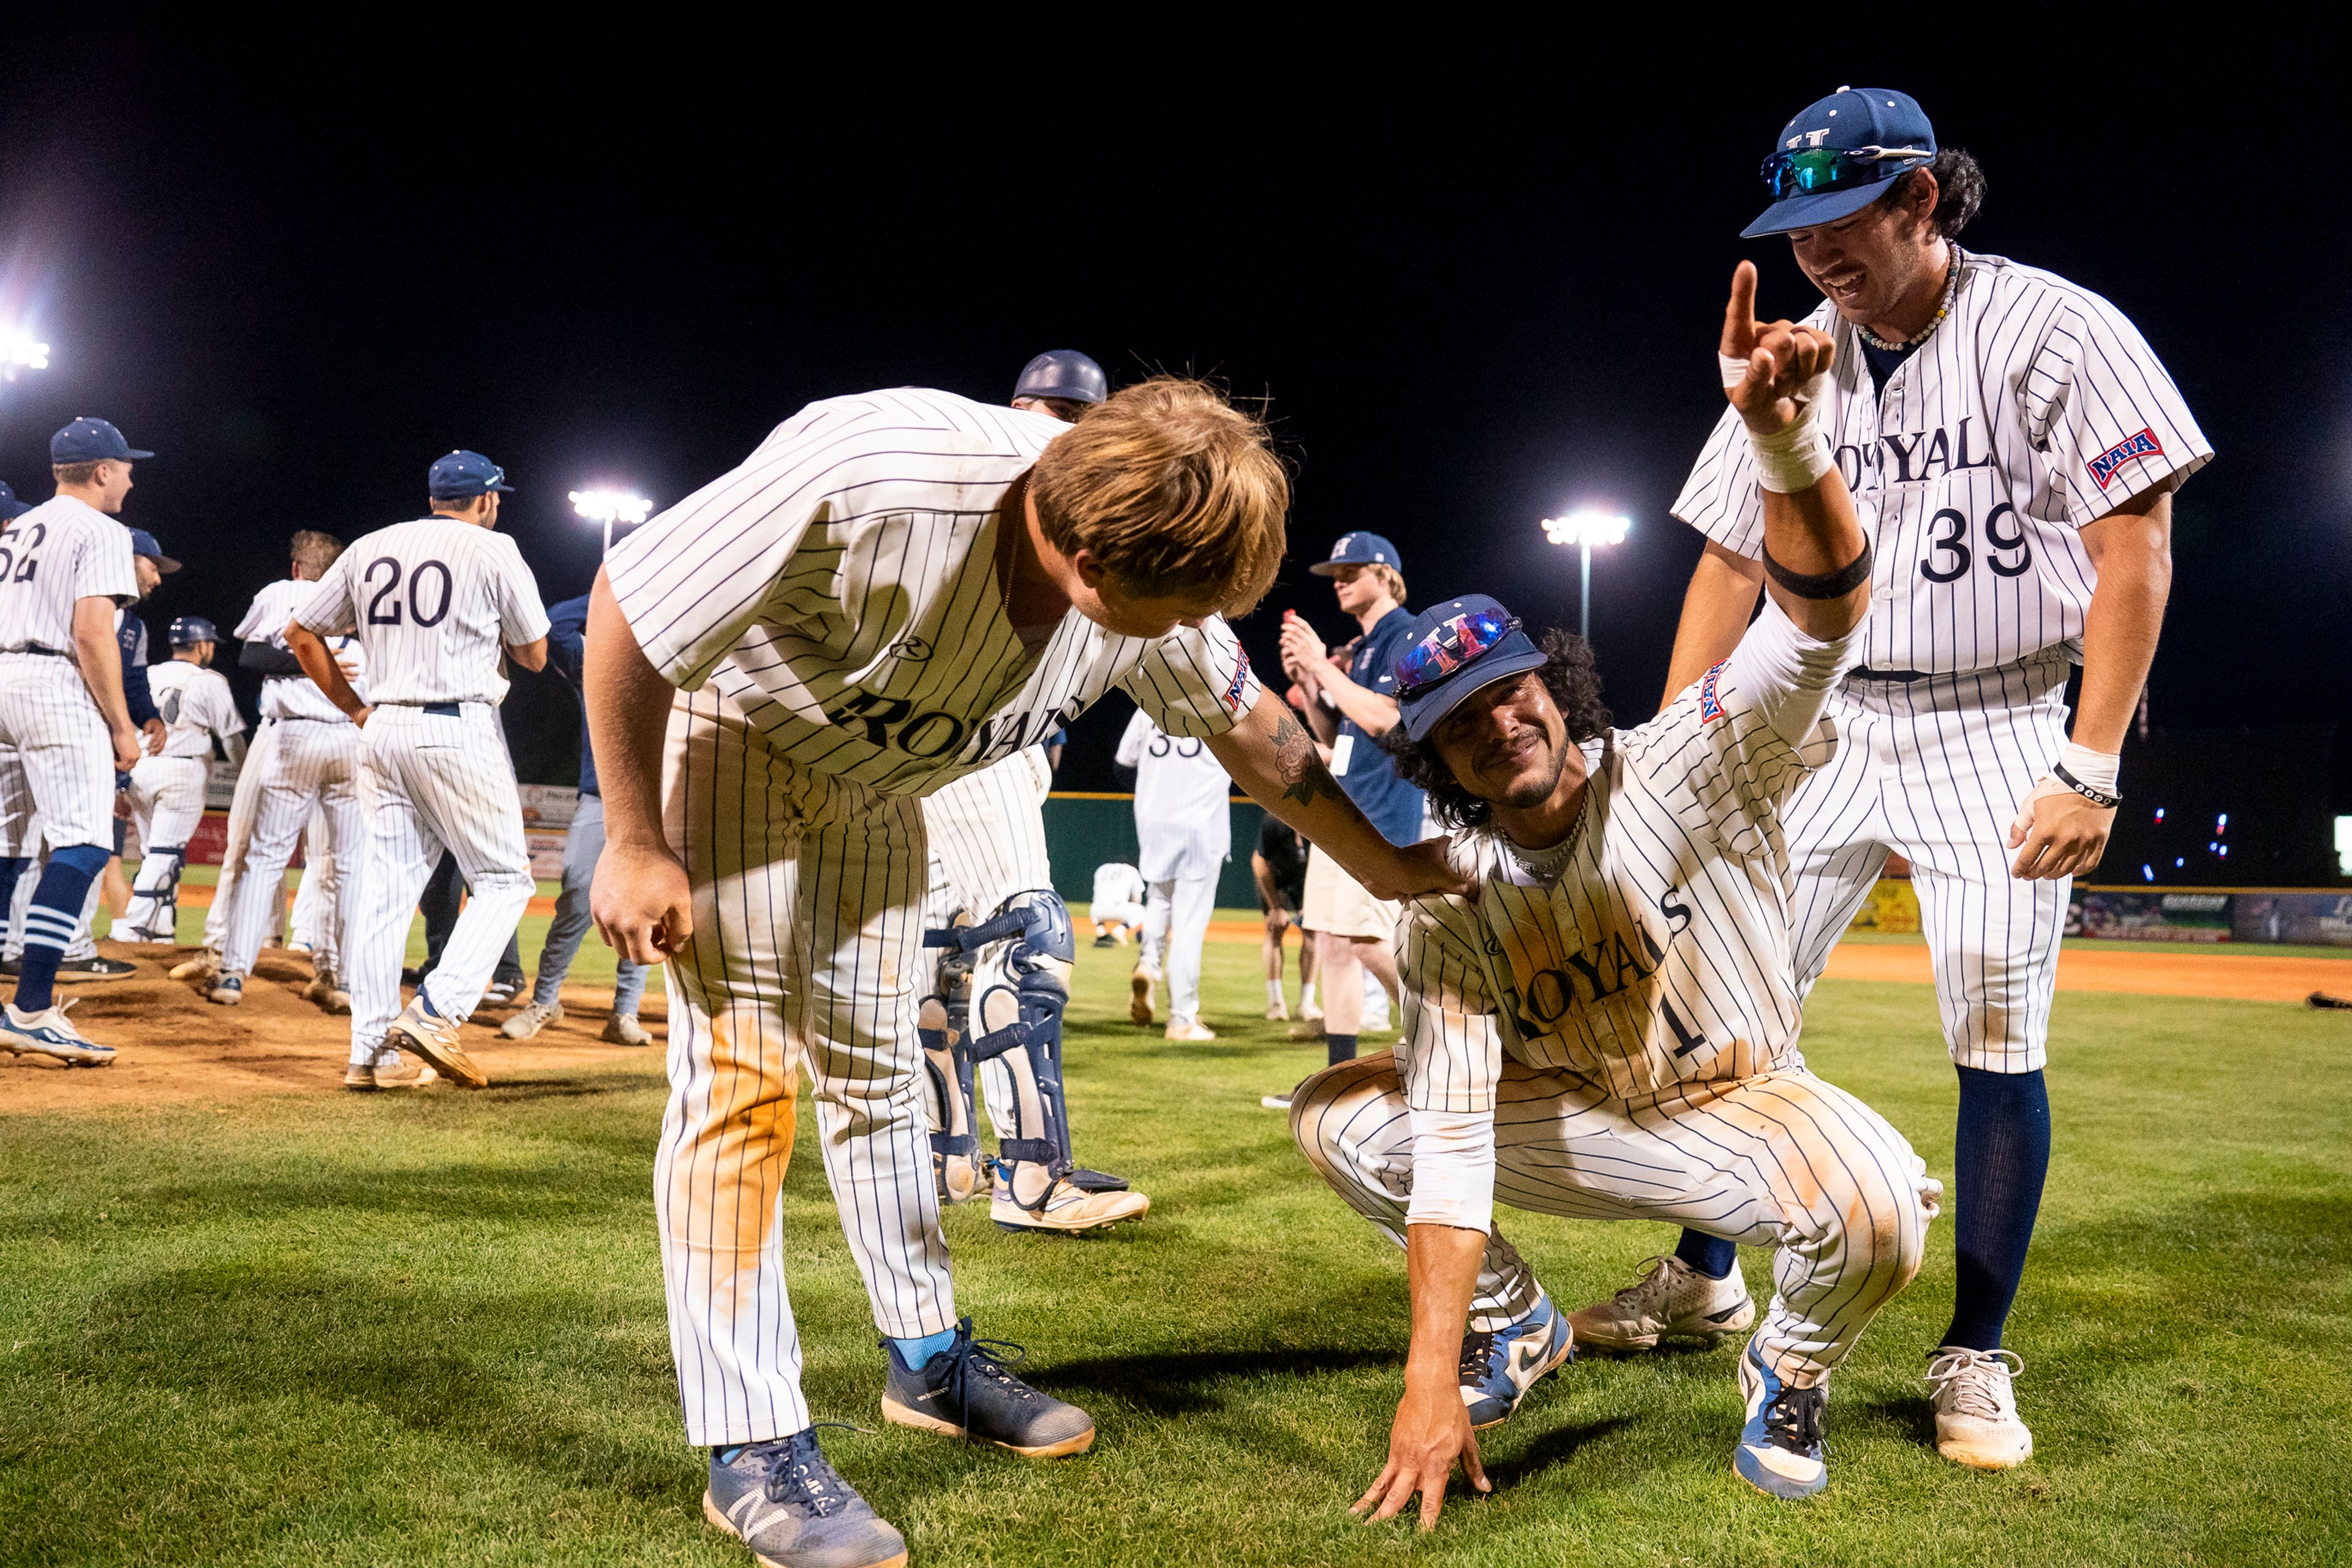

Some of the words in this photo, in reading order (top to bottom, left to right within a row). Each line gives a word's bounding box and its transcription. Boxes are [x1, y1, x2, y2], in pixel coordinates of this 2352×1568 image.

[2091, 433, 2157, 481] NAIA
[0, 522, 46, 582] 52
[1920, 502, 2032, 583] 39
[364, 557, 453, 628] 20
[1229, 648, 1247, 704] NAIA
[1704, 660, 1728, 718] NAIA
[1658, 991, 1706, 1060] 1
